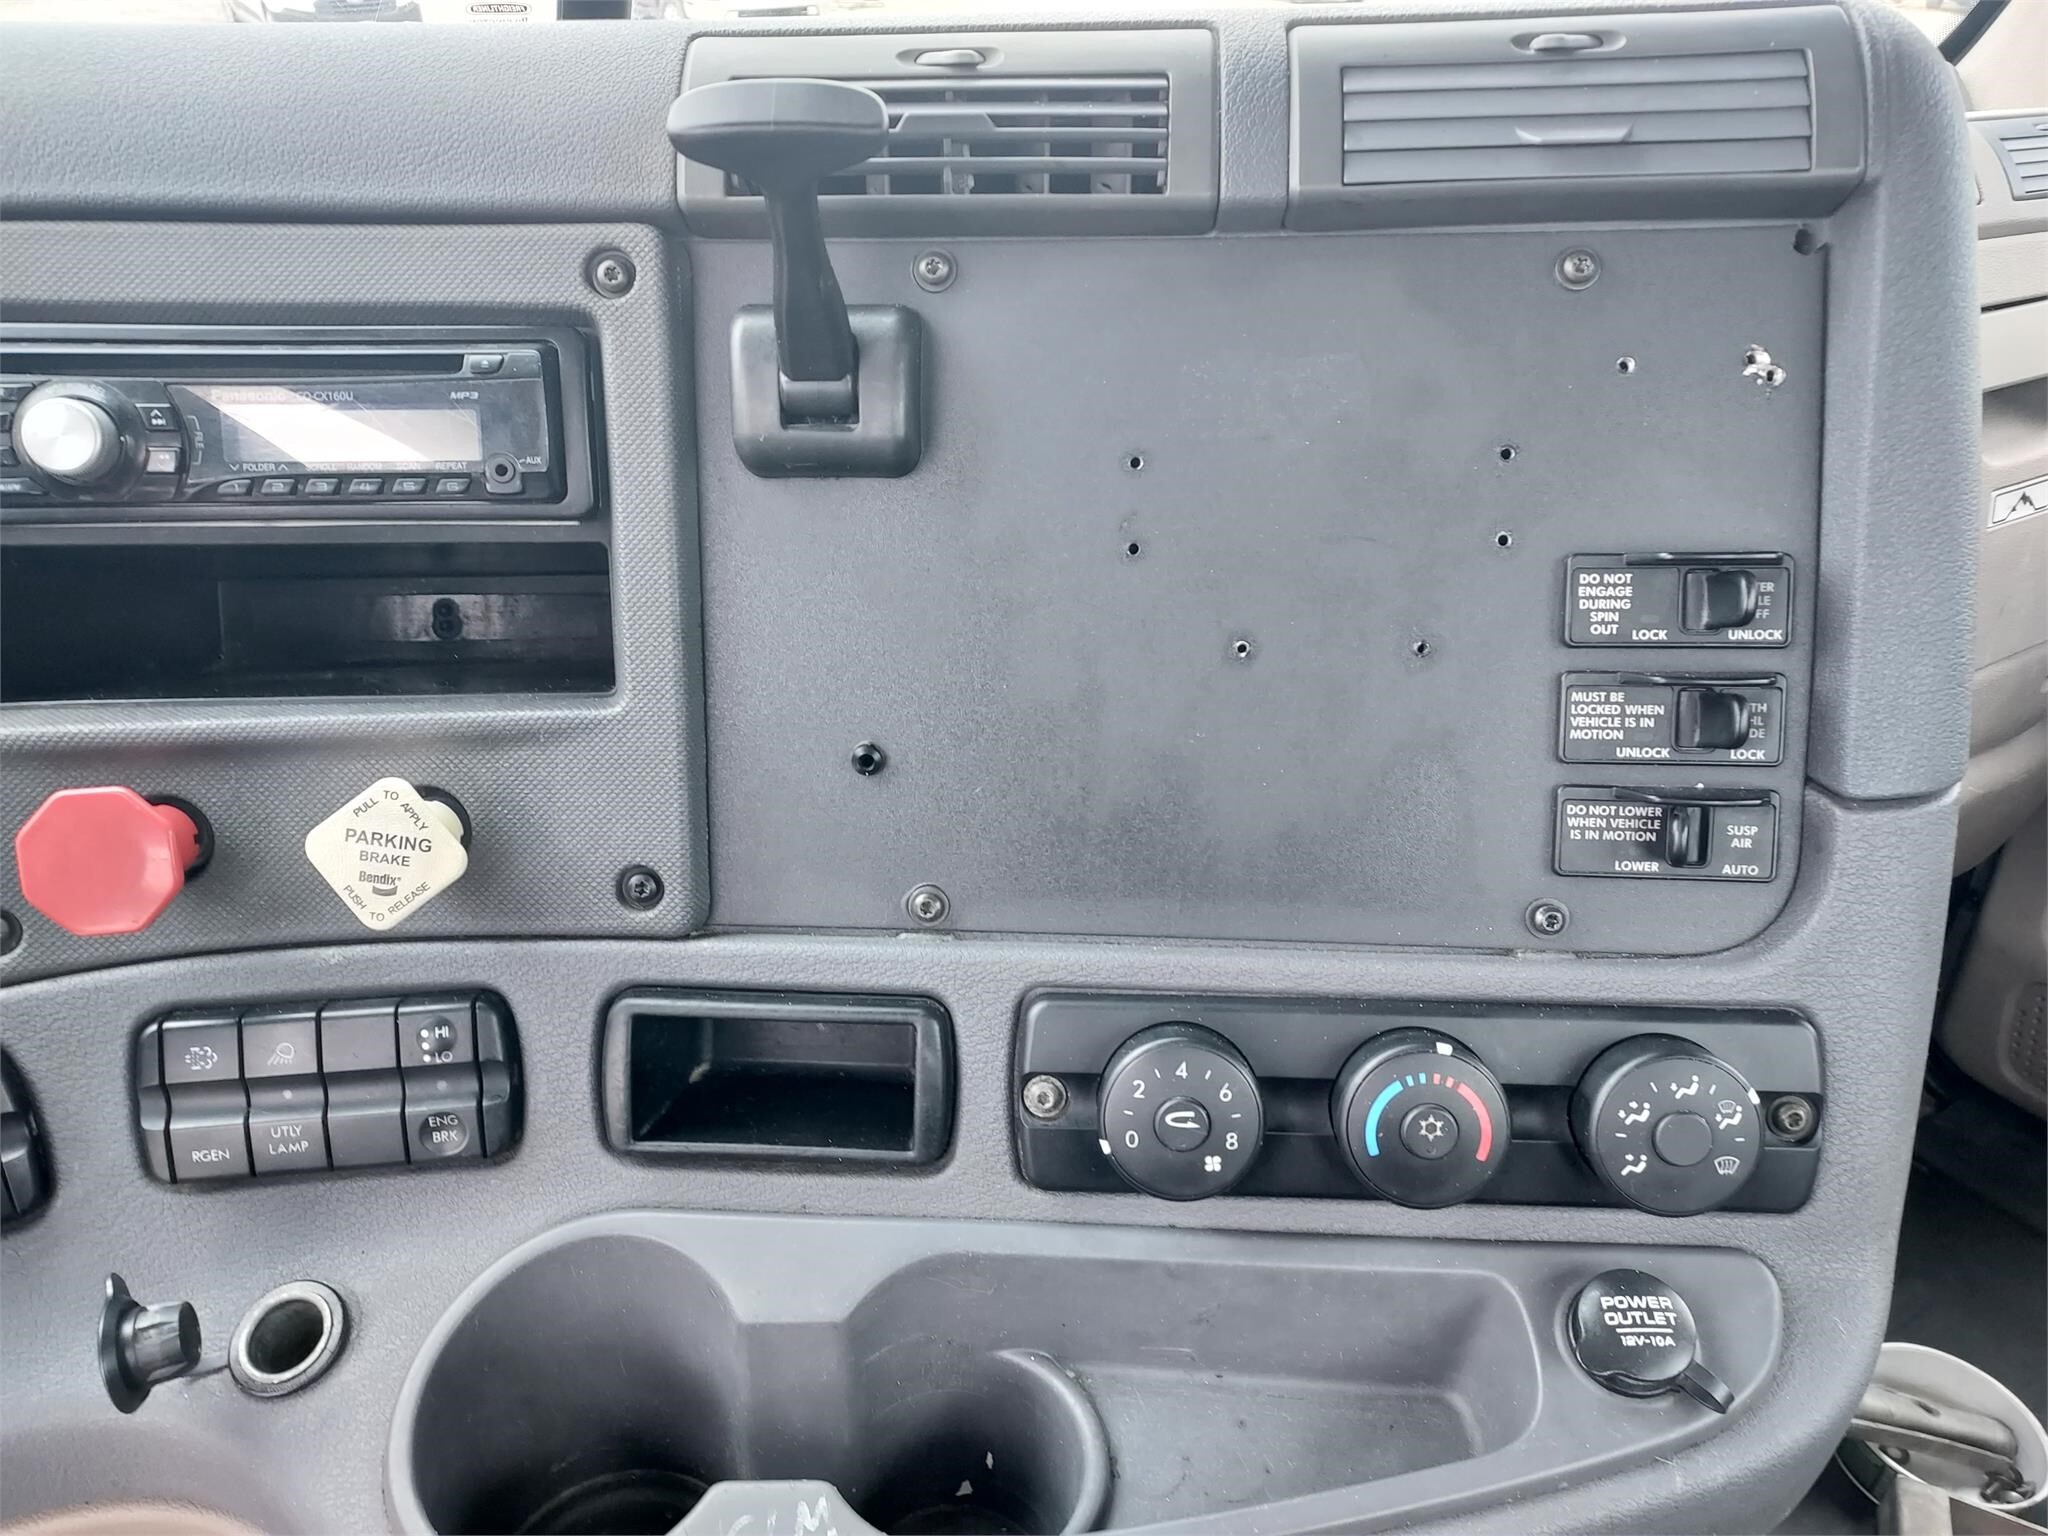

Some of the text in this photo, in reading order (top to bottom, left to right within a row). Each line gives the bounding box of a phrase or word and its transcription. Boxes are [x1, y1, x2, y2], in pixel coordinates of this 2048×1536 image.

[210, 389, 286, 401] Panasonic
[450, 391, 479, 400] MP3
[435, 462, 468, 470] REPEAT
[526, 457, 542, 465] AUX
[242, 463, 276, 472] FOLDER
[232, 483, 240, 491] 1
[271, 482, 284, 492] 2
[316, 482, 328, 492] 3
[359, 482, 371, 491] 4
[402, 481, 415, 491] 5
[446, 482, 459, 491] 6
[1579, 573, 1633, 585] DO NOT
[1578, 586, 1633, 597] ENGAGE
[1756, 582, 1775, 592] ER
[1579, 599, 1631, 610] DURING
[1758, 596, 1771, 605] LE
[1590, 611, 1619, 622] SPIN
[1755, 609, 1770, 618] FF
[1590, 624, 1619, 634] OUT
[1632, 629, 1668, 640] LOCK
[1728, 629, 1783, 640] UNLOCK
[1571, 692, 1625, 702] MUST BE
[1571, 704, 1665, 715] LOCKED WHEN
[1751, 703, 1767, 712] TH
[1570, 717, 1654, 728] VEHICLE IS IN
[1570, 730, 1624, 740] MOTION
[1750, 729, 1765, 738] DE
[1616, 748, 1670, 758] UNLOCK
[1730, 749, 1765, 760] LOCK
[353, 790, 429, 831] PULL TO APPLY
[1566, 805, 1663, 817] DO NOT LOWER
[1567, 818, 1661, 830] WHEN VEHICLE
[1569, 830, 1657, 842] IS IN MOTION
[1727, 825, 1759, 836] SUSP
[345, 828, 432, 852] PARKING
[1730, 838, 1752, 848] AIR
[359, 851, 410, 867] BRAKE
[1614, 860, 1660, 872] LOWER
[1721, 864, 1759, 875] AUTO
[343, 882, 431, 922] PUSH TO RELEASE
[435, 1026, 449, 1039] HI
[435, 1051, 453, 1063] LO
[1175, 1061, 1188, 1079] 4
[1132, 1080, 1145, 1099] 2
[1219, 1082, 1233, 1102] 6
[428, 1114, 459, 1127] ENG
[270, 1124, 302, 1138] UTLY
[432, 1130, 459, 1144] BRK
[1125, 1130, 1139, 1148] 0
[1225, 1132, 1238, 1150] 8
[269, 1140, 309, 1155] LAMP
[192, 1148, 231, 1163] RGEN
[1600, 1295, 1674, 1310] POWER
[1604, 1311, 1677, 1326] OUTLET
[1621, 1335, 1676, 1347] 12V-10A
